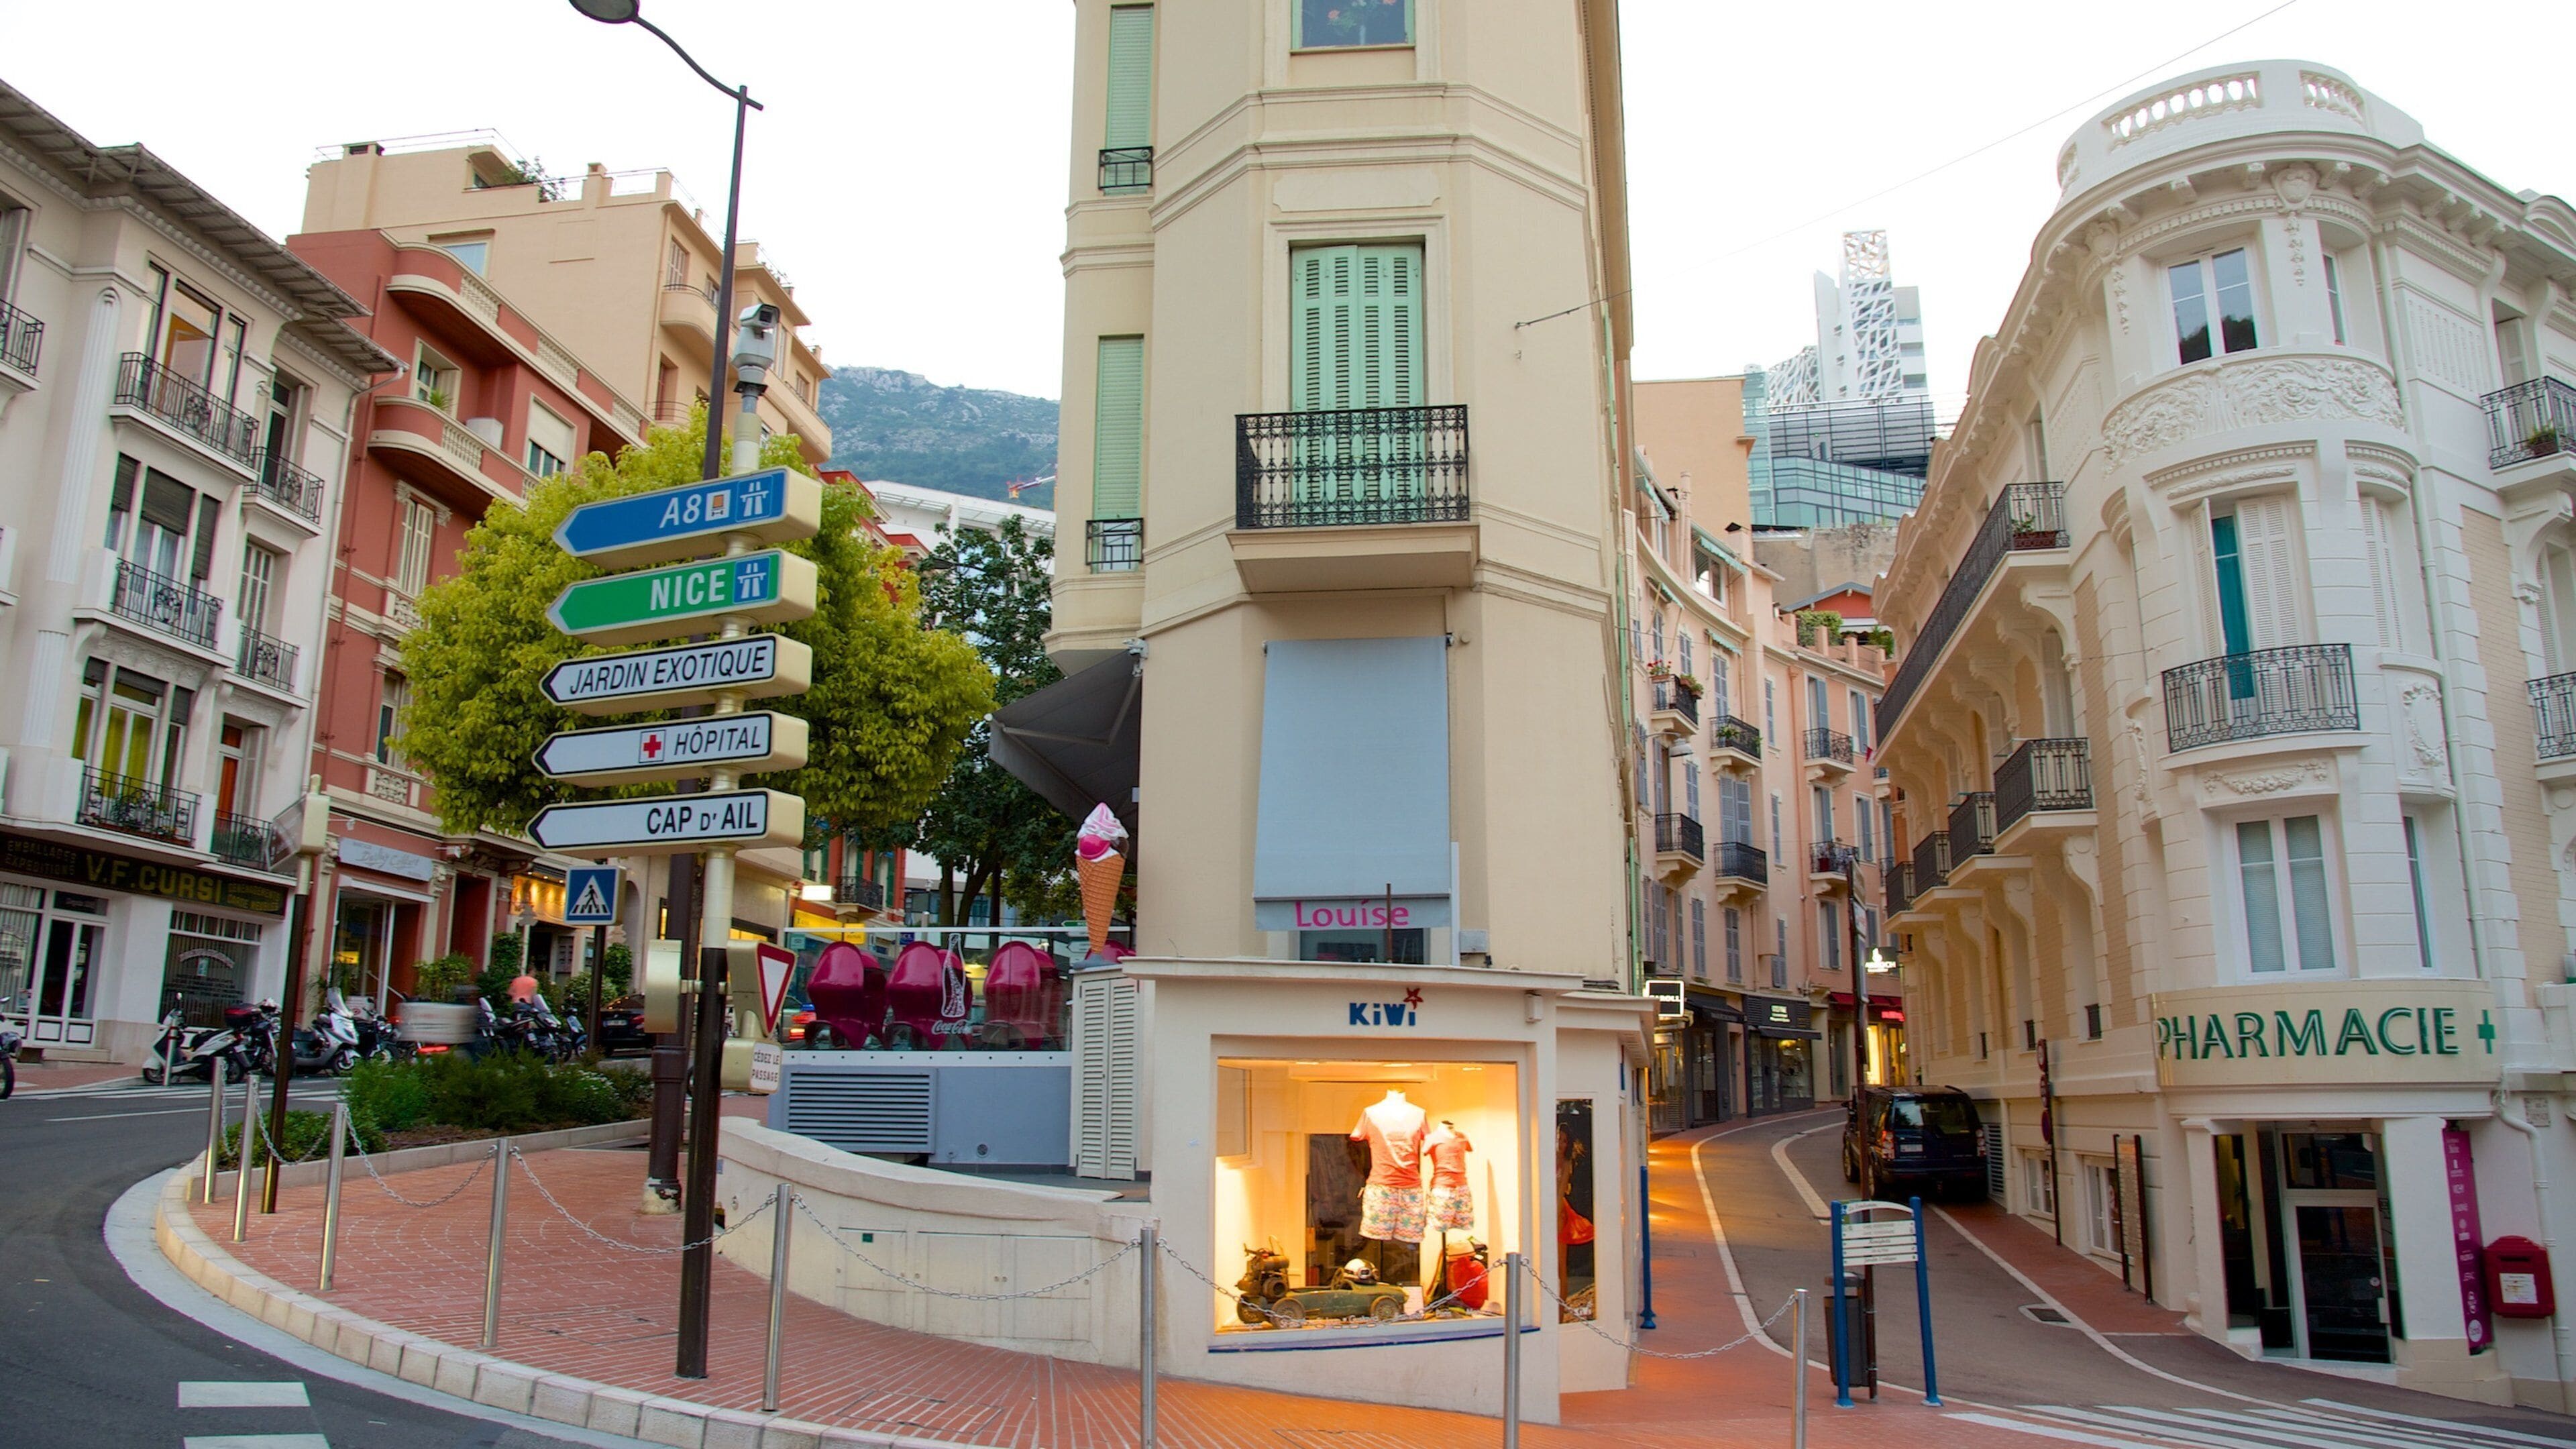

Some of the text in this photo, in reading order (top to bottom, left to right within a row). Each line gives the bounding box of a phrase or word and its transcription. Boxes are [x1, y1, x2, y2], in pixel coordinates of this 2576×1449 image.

[659, 494, 702, 529] A8
[650, 568, 726, 611] NICE
[570, 645, 767, 695] JARDIN EXOTIQUE
[674, 725, 761, 755] HÔPITAL
[647, 806, 692, 835] CAP
[1295, 899, 1409, 928] Louise
[2155, 1006, 2461, 1060] PHARMACIE
[754, 1049, 780, 1065] CÉDEZ LE
[752, 1069, 778, 1083] PASSAGE
